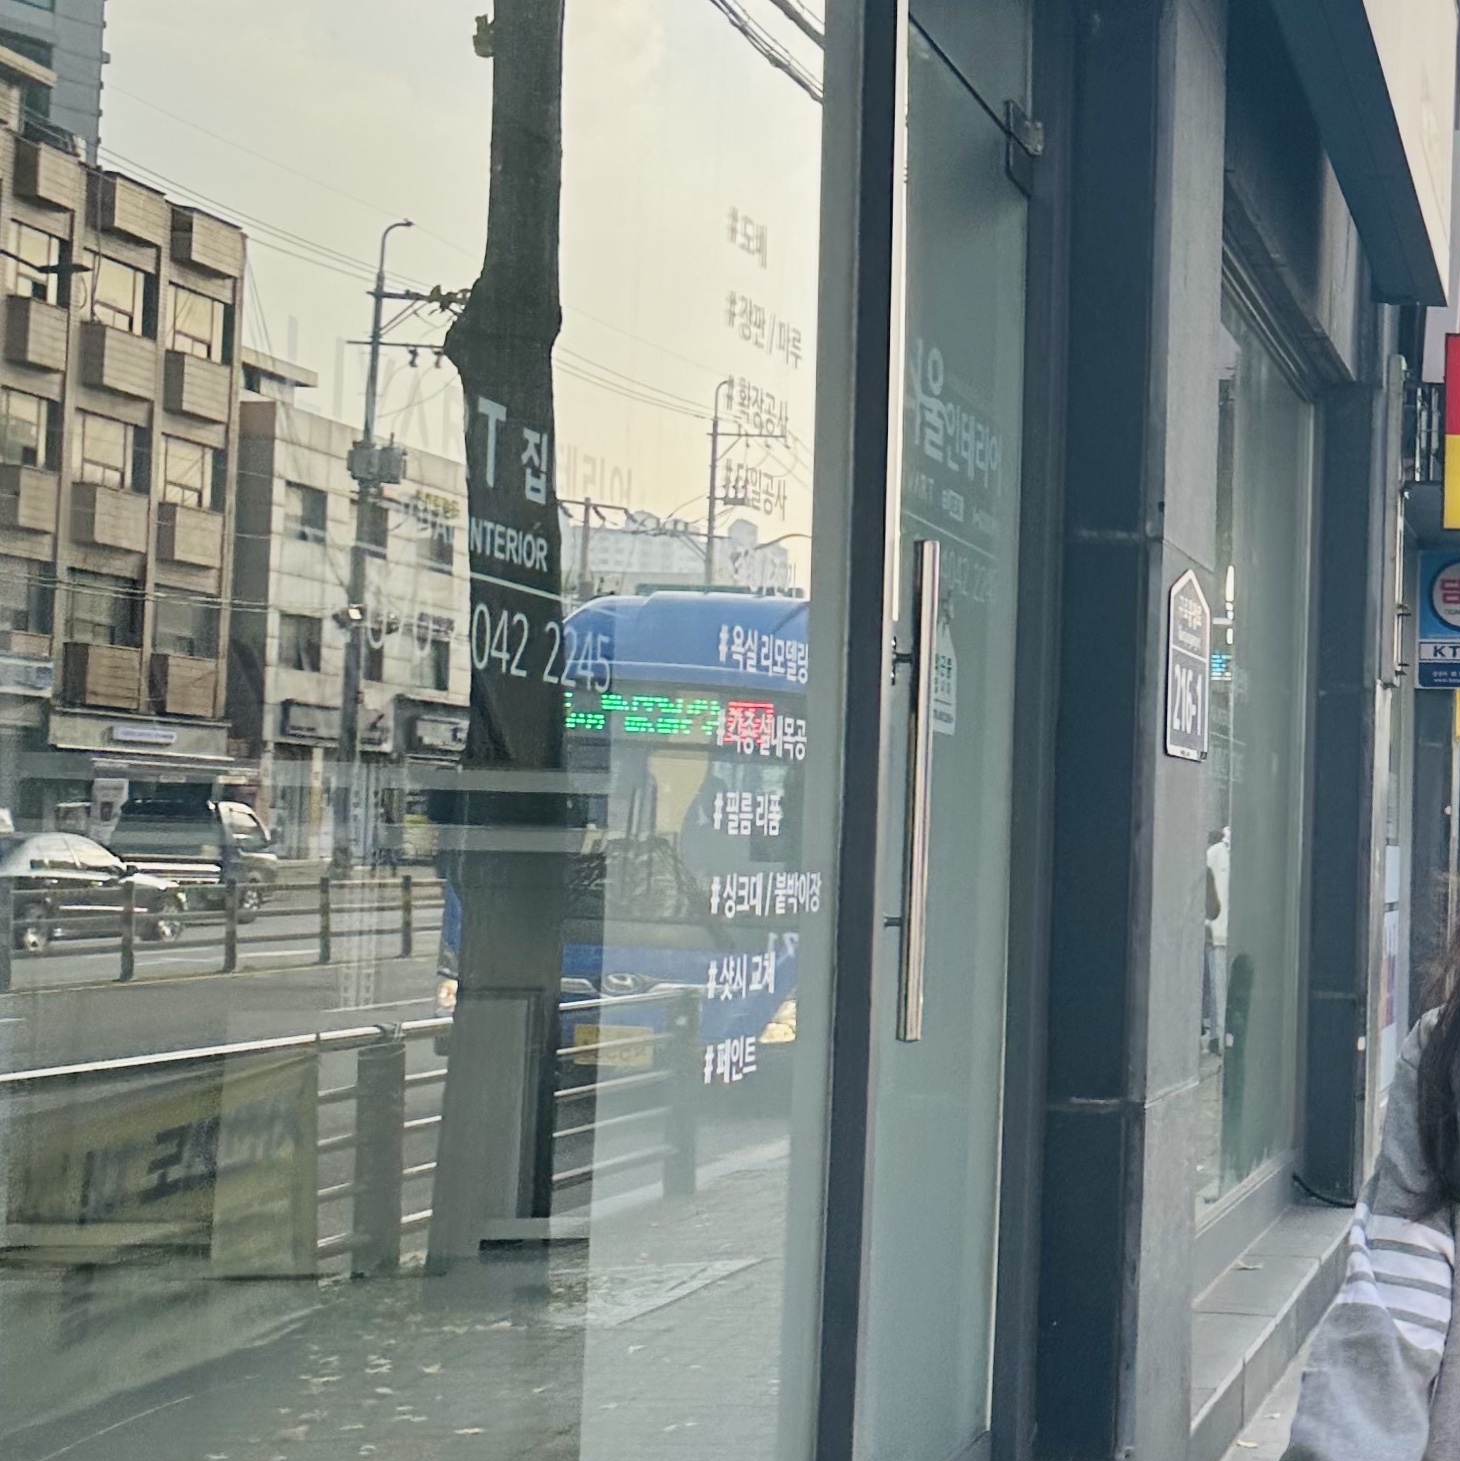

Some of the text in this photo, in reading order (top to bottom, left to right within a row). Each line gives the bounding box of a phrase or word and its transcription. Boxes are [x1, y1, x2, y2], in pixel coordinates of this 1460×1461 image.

[468, 516, 549, 573] NTERIOR
[543, 620, 611, 692] 2245
[761, 634, 809, 684] 리모델링
[774, 871, 822, 914] 붙박이장
[749, 952, 776, 994] 교체
[704, 1036, 757, 1084] #페인트
